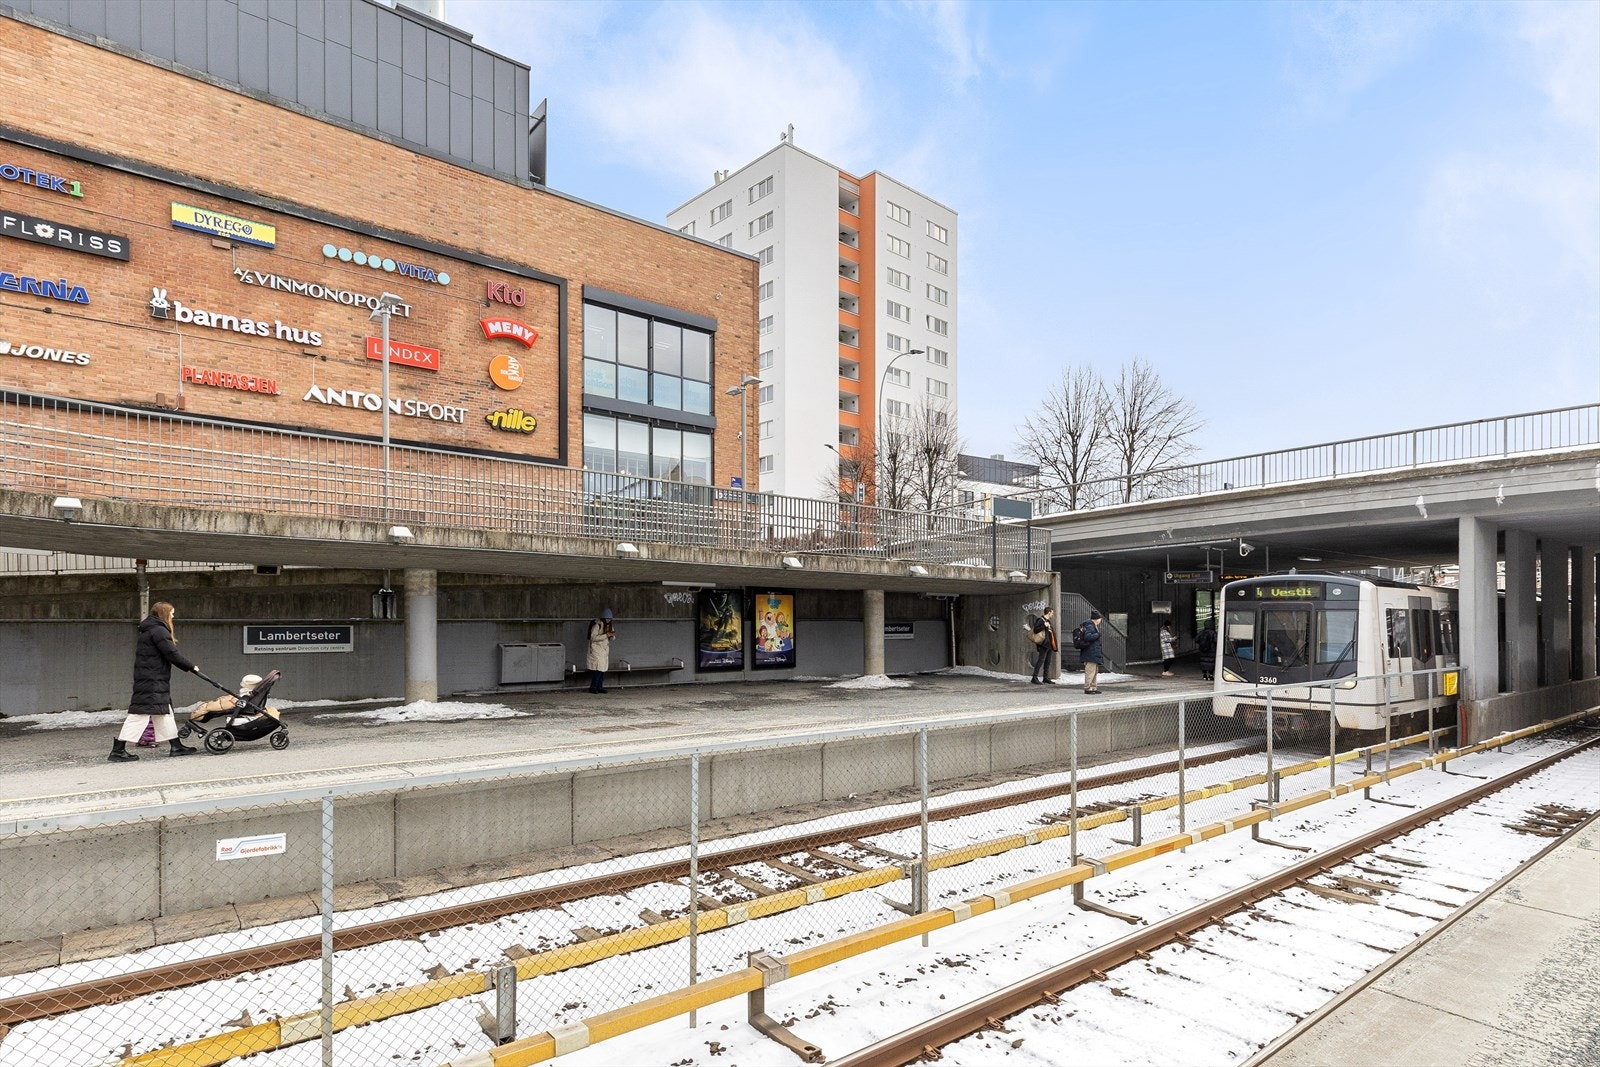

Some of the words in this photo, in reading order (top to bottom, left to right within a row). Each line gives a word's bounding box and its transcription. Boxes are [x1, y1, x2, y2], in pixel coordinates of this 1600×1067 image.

[3, 215, 122, 254] FLORISS
[194, 211, 253, 235] DYREGO
[397, 261, 437, 283] VITA
[254, 270, 412, 318] VINMONOPOET
[486, 279, 526, 307] Kid
[173, 300, 270, 339] barnas
[275, 320, 322, 347] hus
[487, 321, 535, 341] MENY
[10, 343, 91, 366] JONES
[373, 342, 433, 364] LNDEX
[182, 366, 278, 395] PLANTASJEN
[303, 384, 402, 414] ANTON
[404, 399, 469, 424] SPORT
[1256, 587, 1263, 597] 4
[1271, 588, 1312, 597] Vestli
[259, 631, 341, 641] Lambertseter
[1259, 676, 1278, 684] 3360
